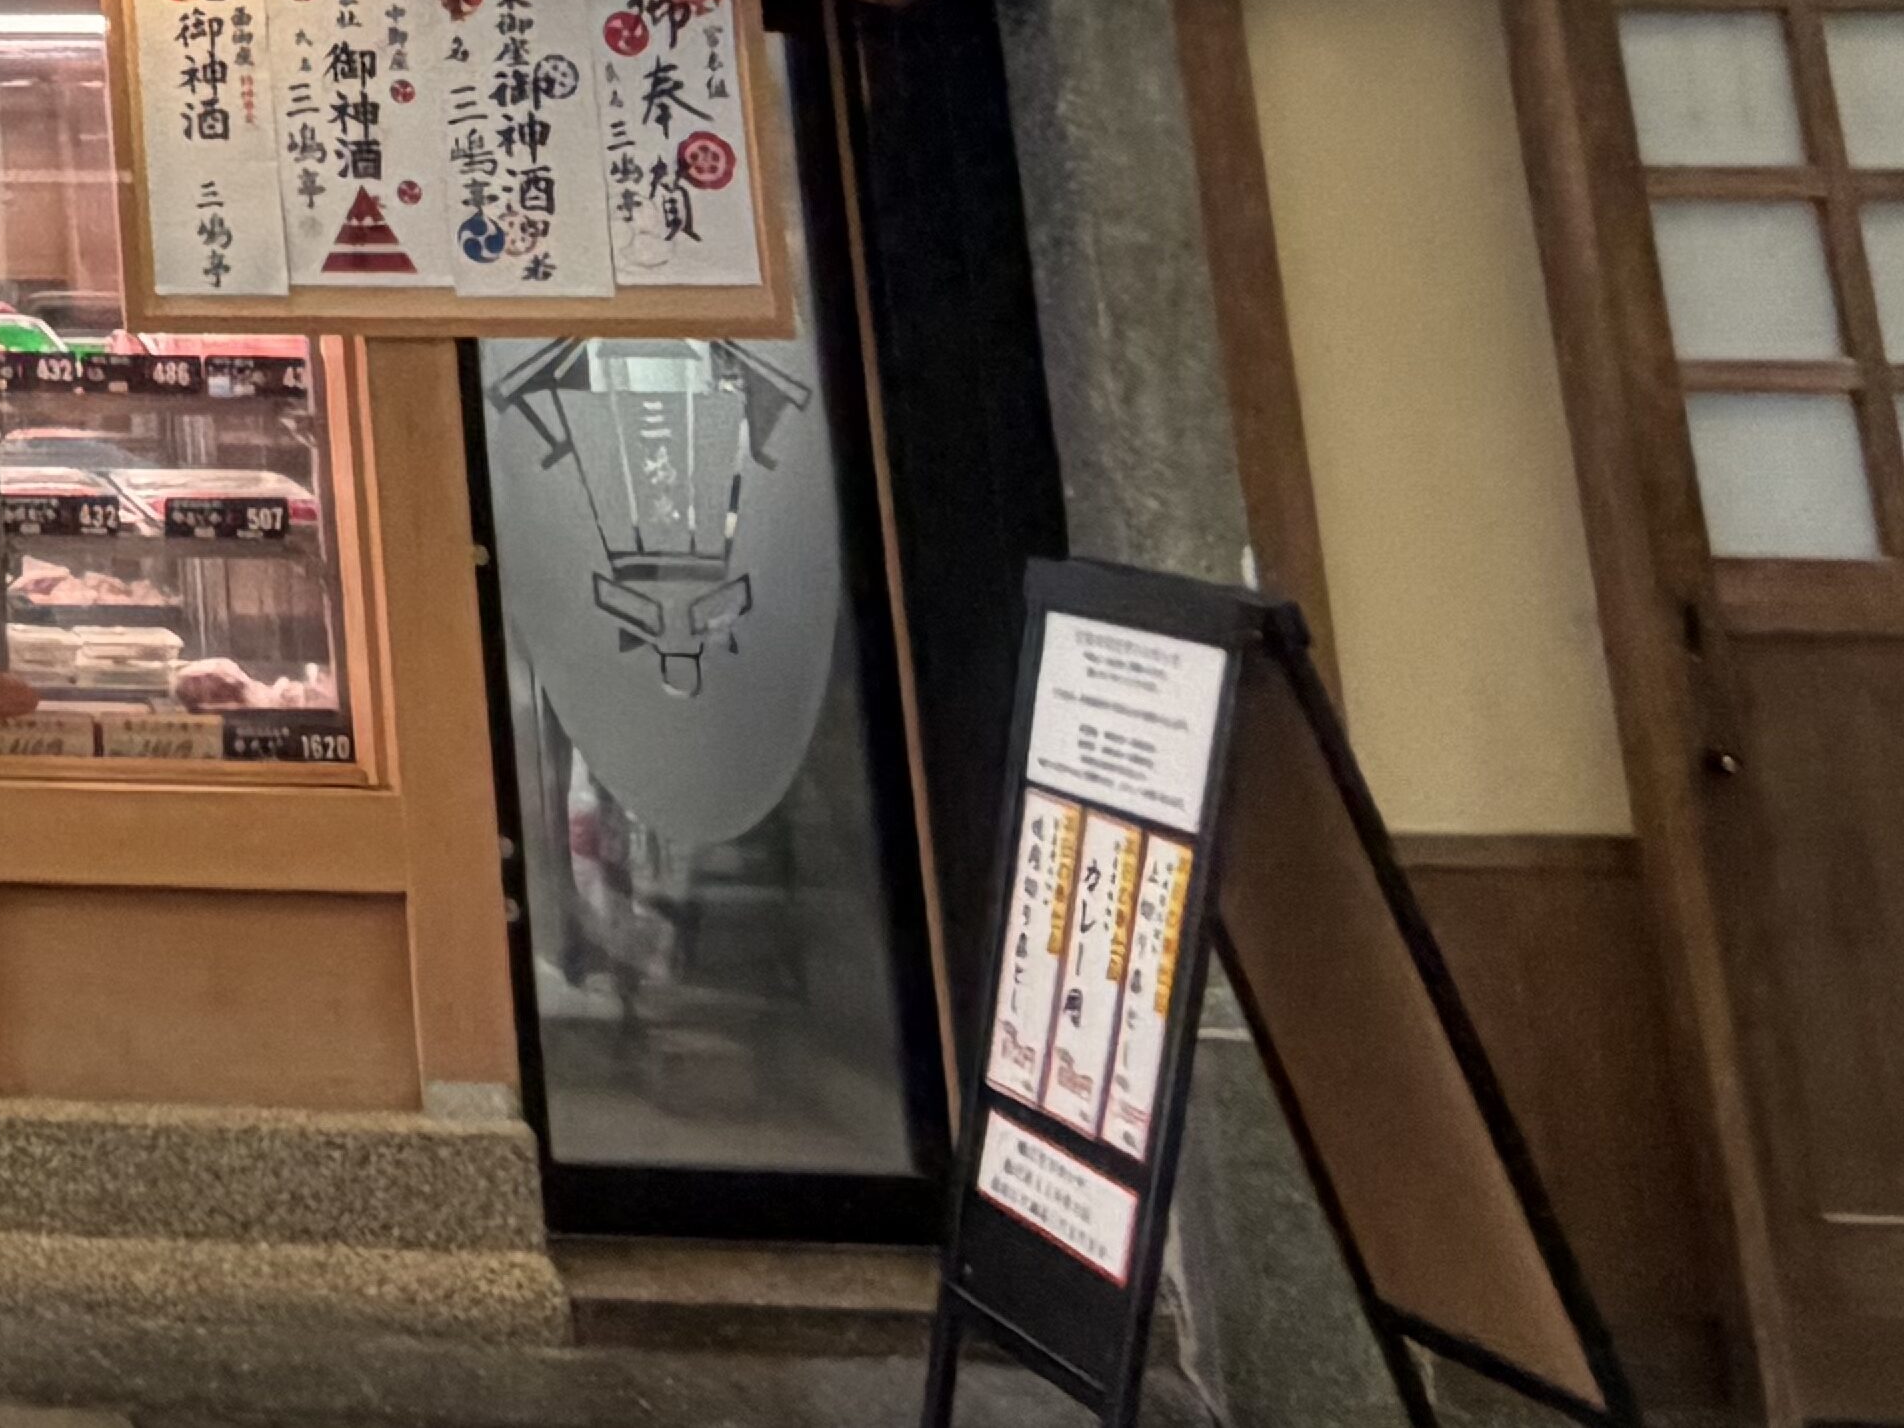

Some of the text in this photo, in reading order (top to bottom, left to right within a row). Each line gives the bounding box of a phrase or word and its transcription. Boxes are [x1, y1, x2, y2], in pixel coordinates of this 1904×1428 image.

[174, 7, 230, 141] 御神酒
[323, 40, 382, 181] 御神酒
[286, 82, 328, 210] 三嶋亭
[488, 69, 556, 215] 御神酒
[300, 734, 351, 761] 1620
